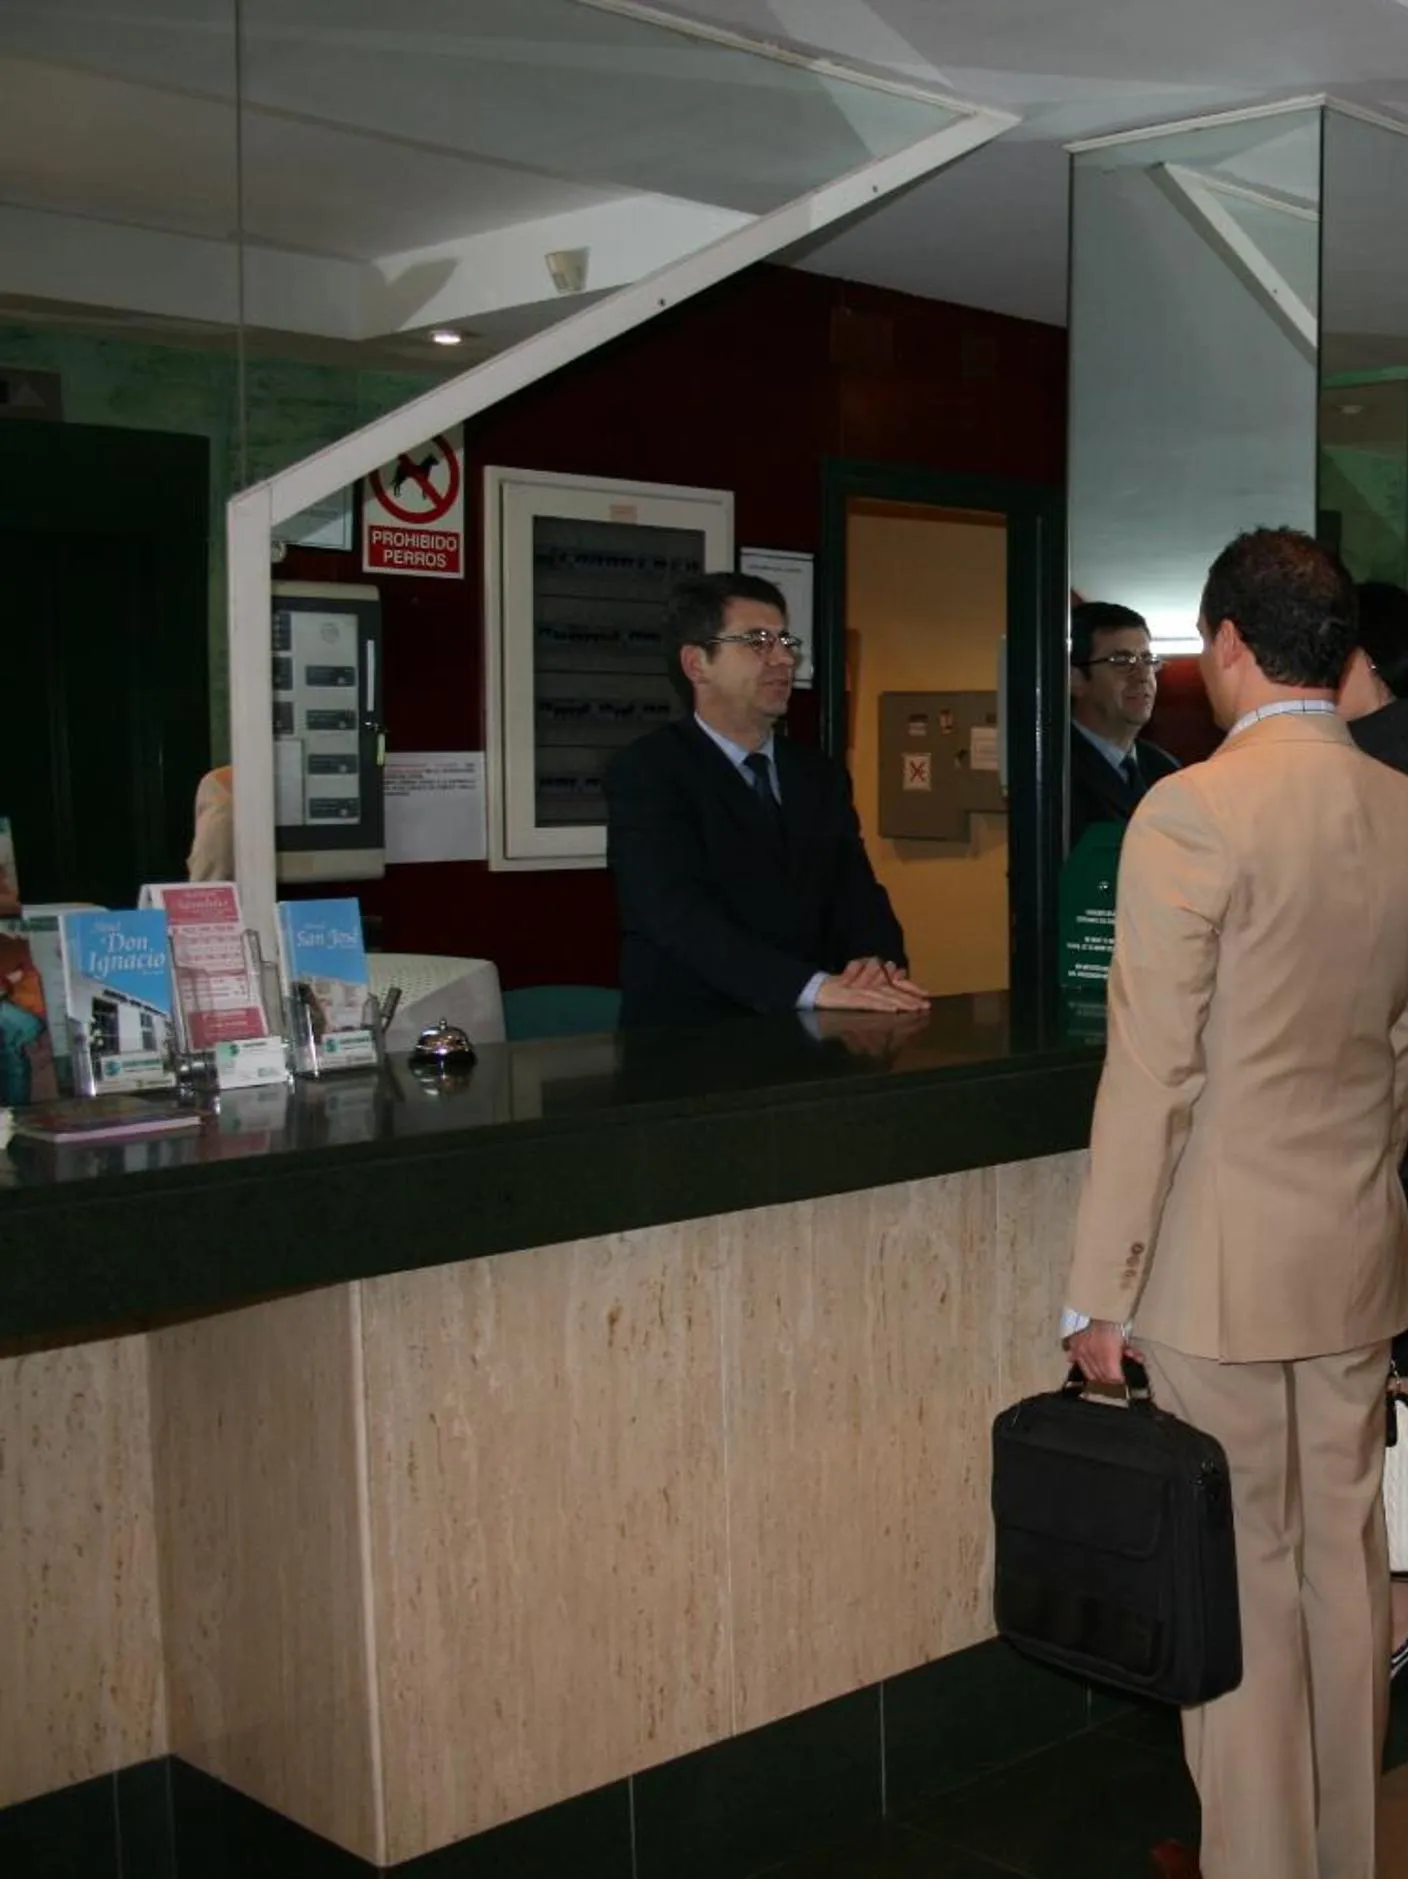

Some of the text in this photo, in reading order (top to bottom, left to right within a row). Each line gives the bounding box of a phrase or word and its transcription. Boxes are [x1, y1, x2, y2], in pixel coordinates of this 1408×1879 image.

[371, 530, 457, 552] PROHIBIDO
[383, 549, 447, 568] PERROS
[107, 931, 149, 954] Don
[296, 930, 325, 948] San
[88, 946, 167, 980] Ignacio
